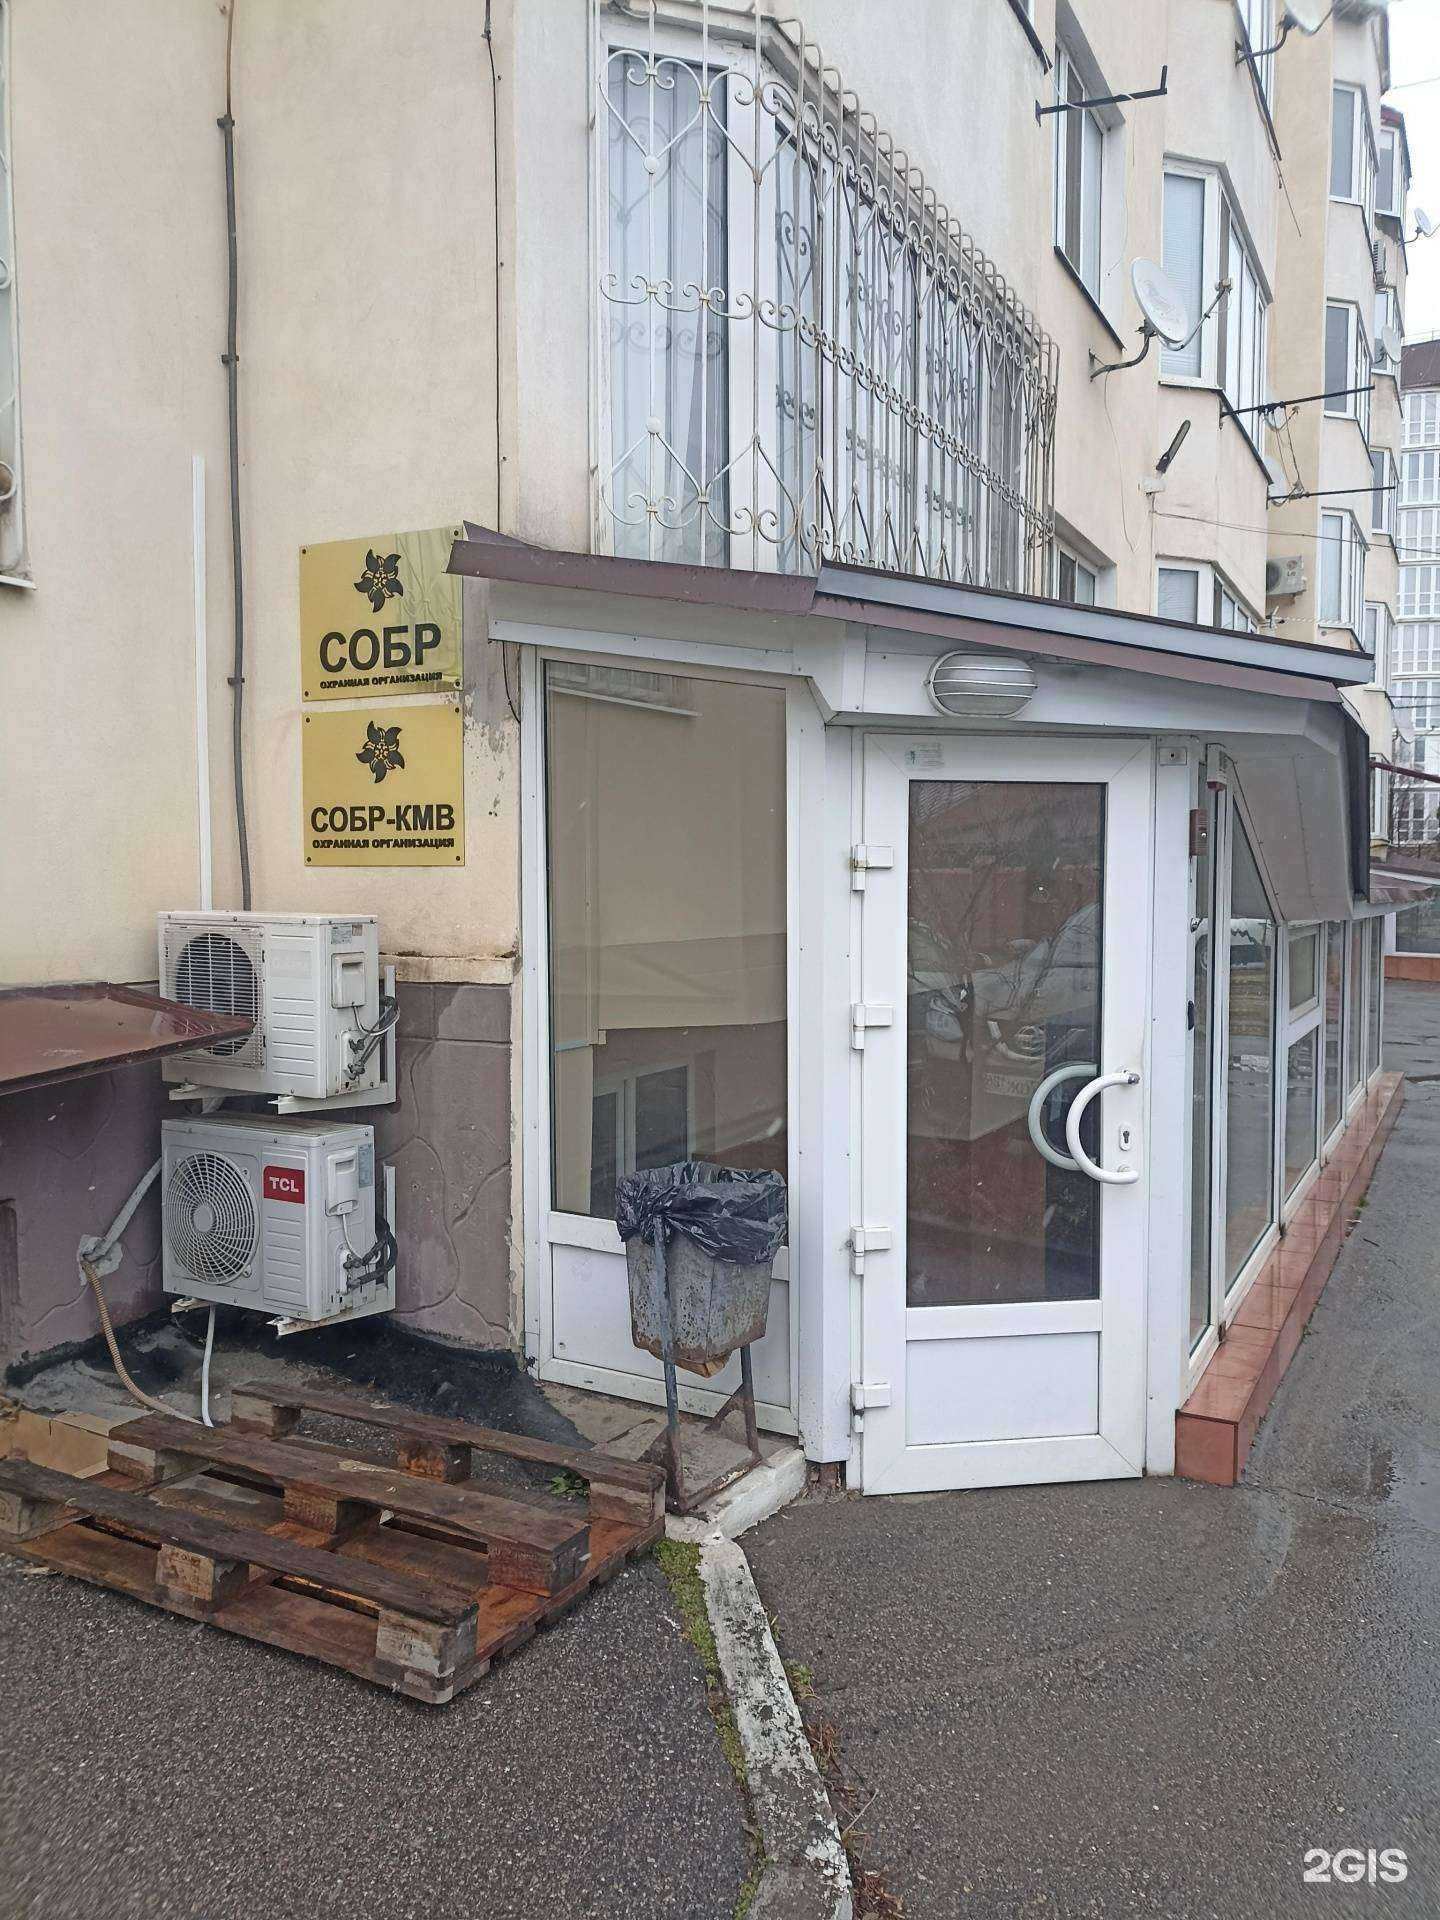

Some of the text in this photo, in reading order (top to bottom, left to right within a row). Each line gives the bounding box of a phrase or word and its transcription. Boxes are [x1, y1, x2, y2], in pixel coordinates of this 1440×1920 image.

[319, 621, 442, 673] СОБР
[319, 671, 443, 689] ОХРАННАЯ ОРГАНИЗАЦИЯ
[310, 803, 455, 833] СОБР-КМВ
[312, 837, 455, 849] ОХРАННАЯ ОРГАНИЗАЦИЯ
[269, 1176, 300, 1193] TCL
